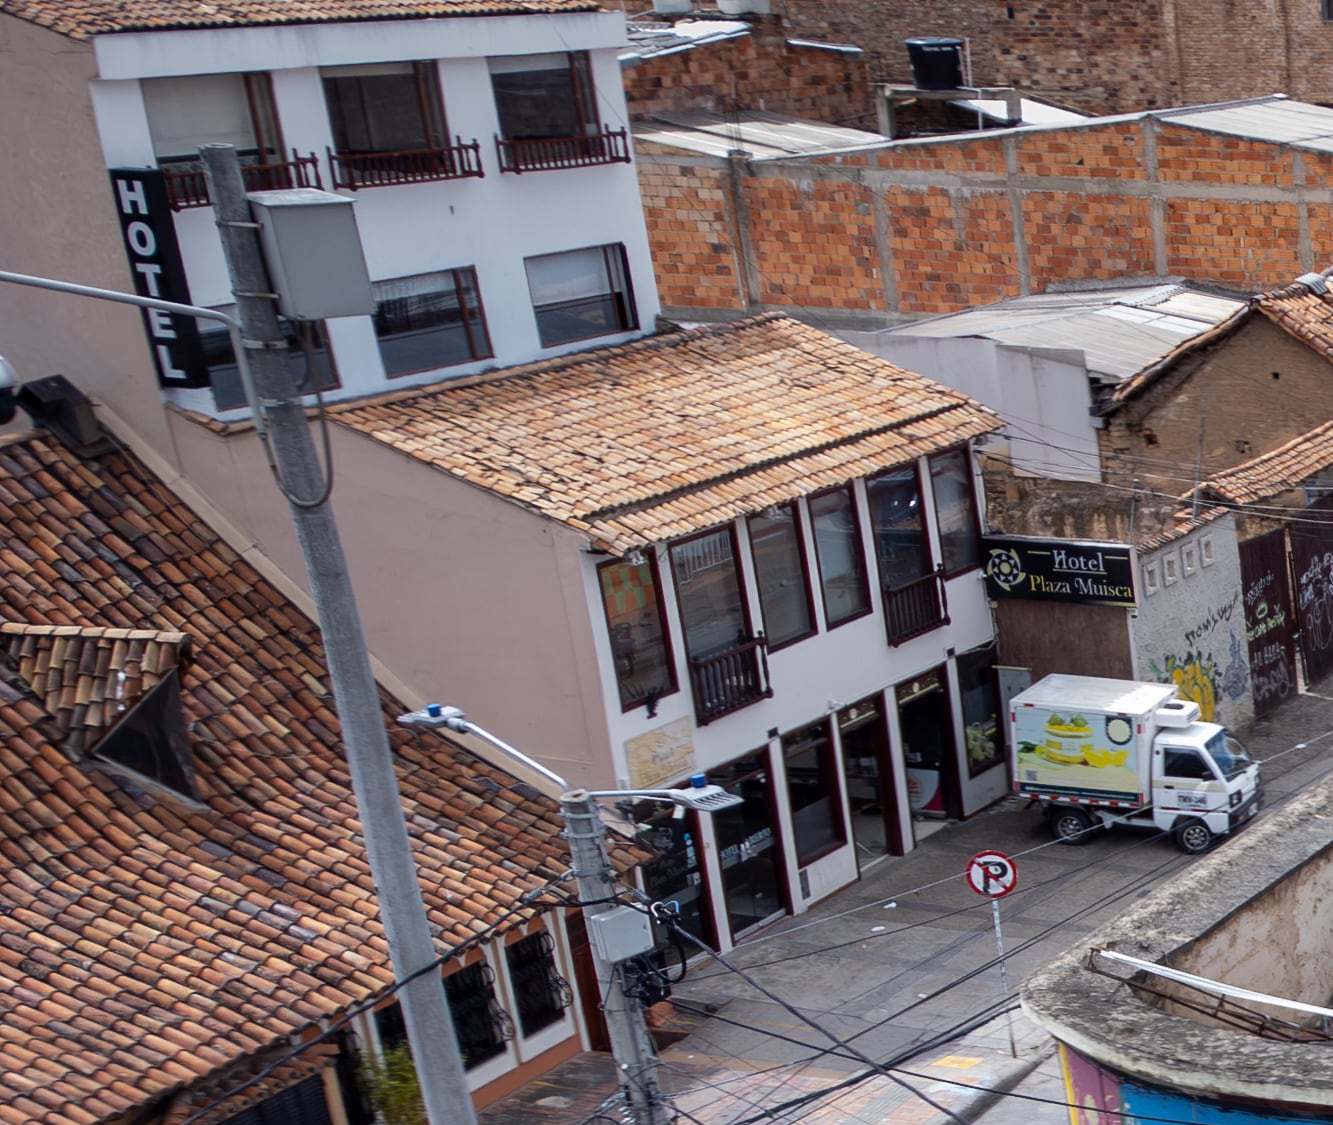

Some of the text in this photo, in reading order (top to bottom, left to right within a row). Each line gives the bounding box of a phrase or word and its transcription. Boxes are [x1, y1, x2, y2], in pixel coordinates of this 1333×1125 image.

[116, 179, 187, 379] HOTEL
[1053, 549, 1105, 572] Hotel
[1029, 574, 1133, 598] Plaza Muisca
